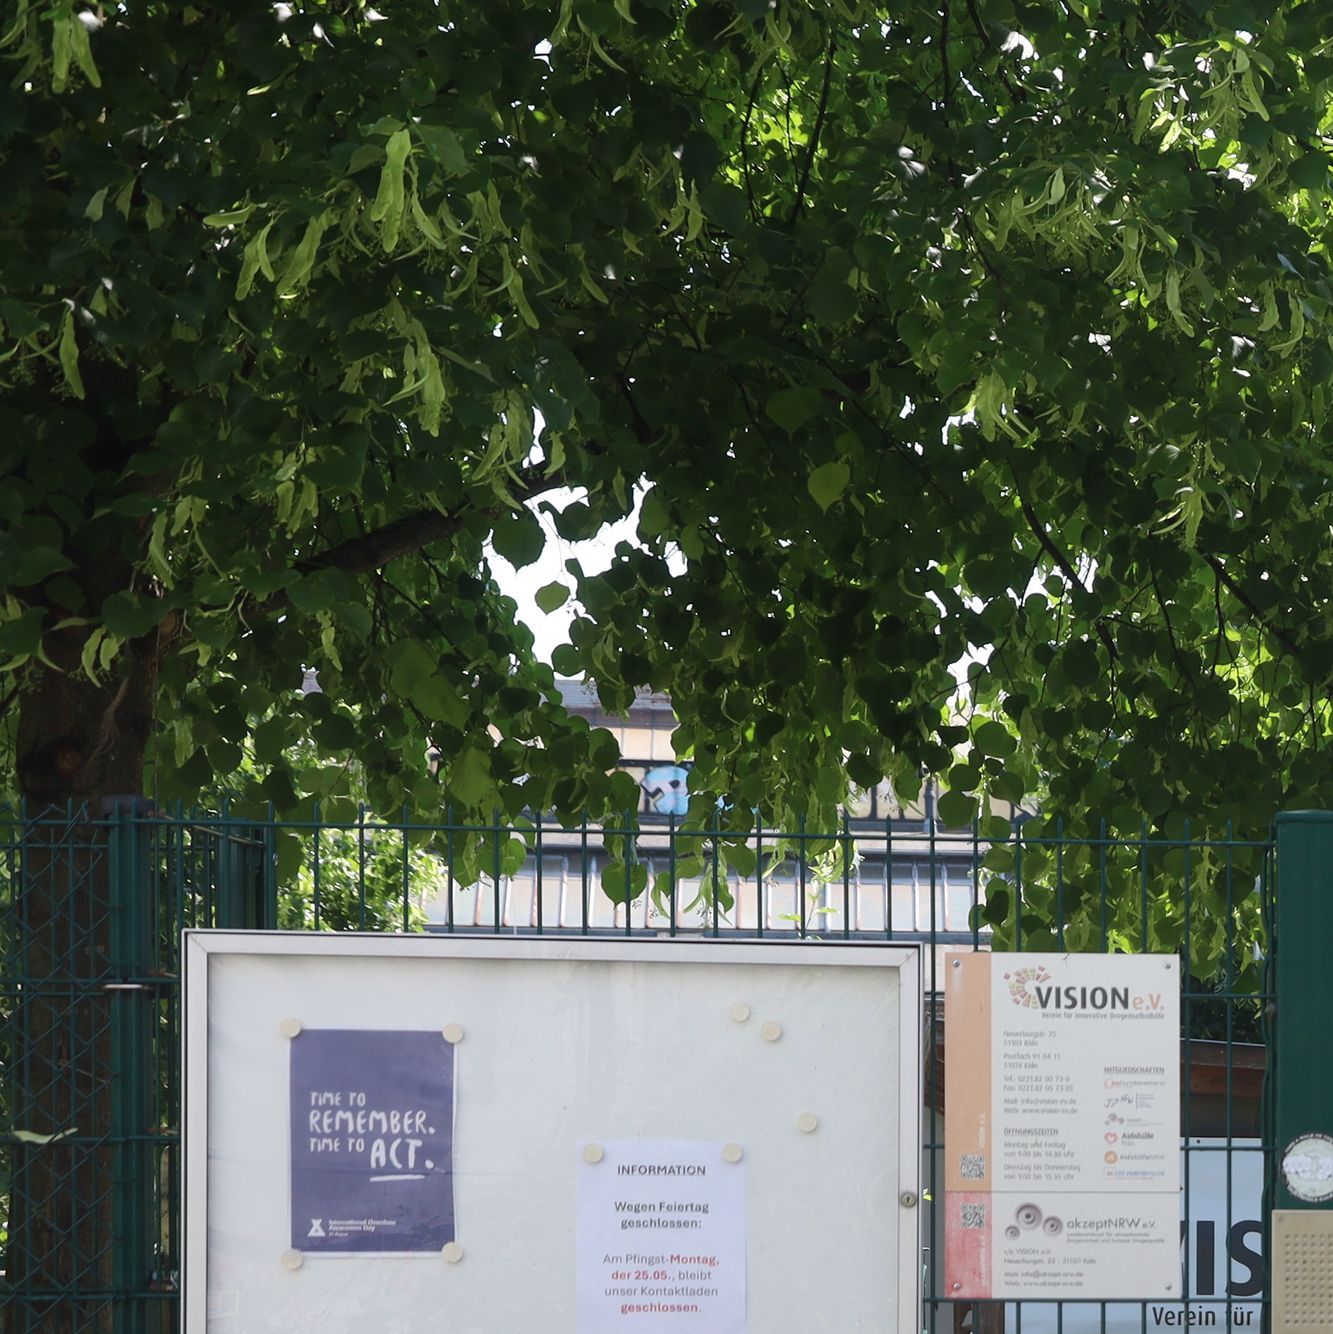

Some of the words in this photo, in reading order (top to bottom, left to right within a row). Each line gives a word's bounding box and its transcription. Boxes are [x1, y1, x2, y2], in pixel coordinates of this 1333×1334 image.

[1035, 986, 1129, 1010] VISION
[1132, 993, 1165, 1010] e.V.
[349, 1092, 366, 1106] TO
[309, 1109, 436, 1135] REMEMBER.
[347, 1138, 365, 1152] TO
[370, 1138, 435, 1169] ACT.
[617, 1165, 706, 1176] INFORMATION
[614, 1201, 656, 1213] Wegen
[659, 1201, 710, 1213] Feiertag
[620, 1217, 702, 1230] geschlossen:
[602, 1254, 622, 1264] Am
[611, 1270, 632, 1280] der
[678, 1270, 712, 1280] bleibt
[604, 1287, 638, 1297] unser
[640, 1286, 719, 1297] Kontaktladen
[620, 1302, 702, 1315] geschlossen.
[1151, 1306, 1216, 1326] Verein
[1225, 1306, 1254, 1326] ür
